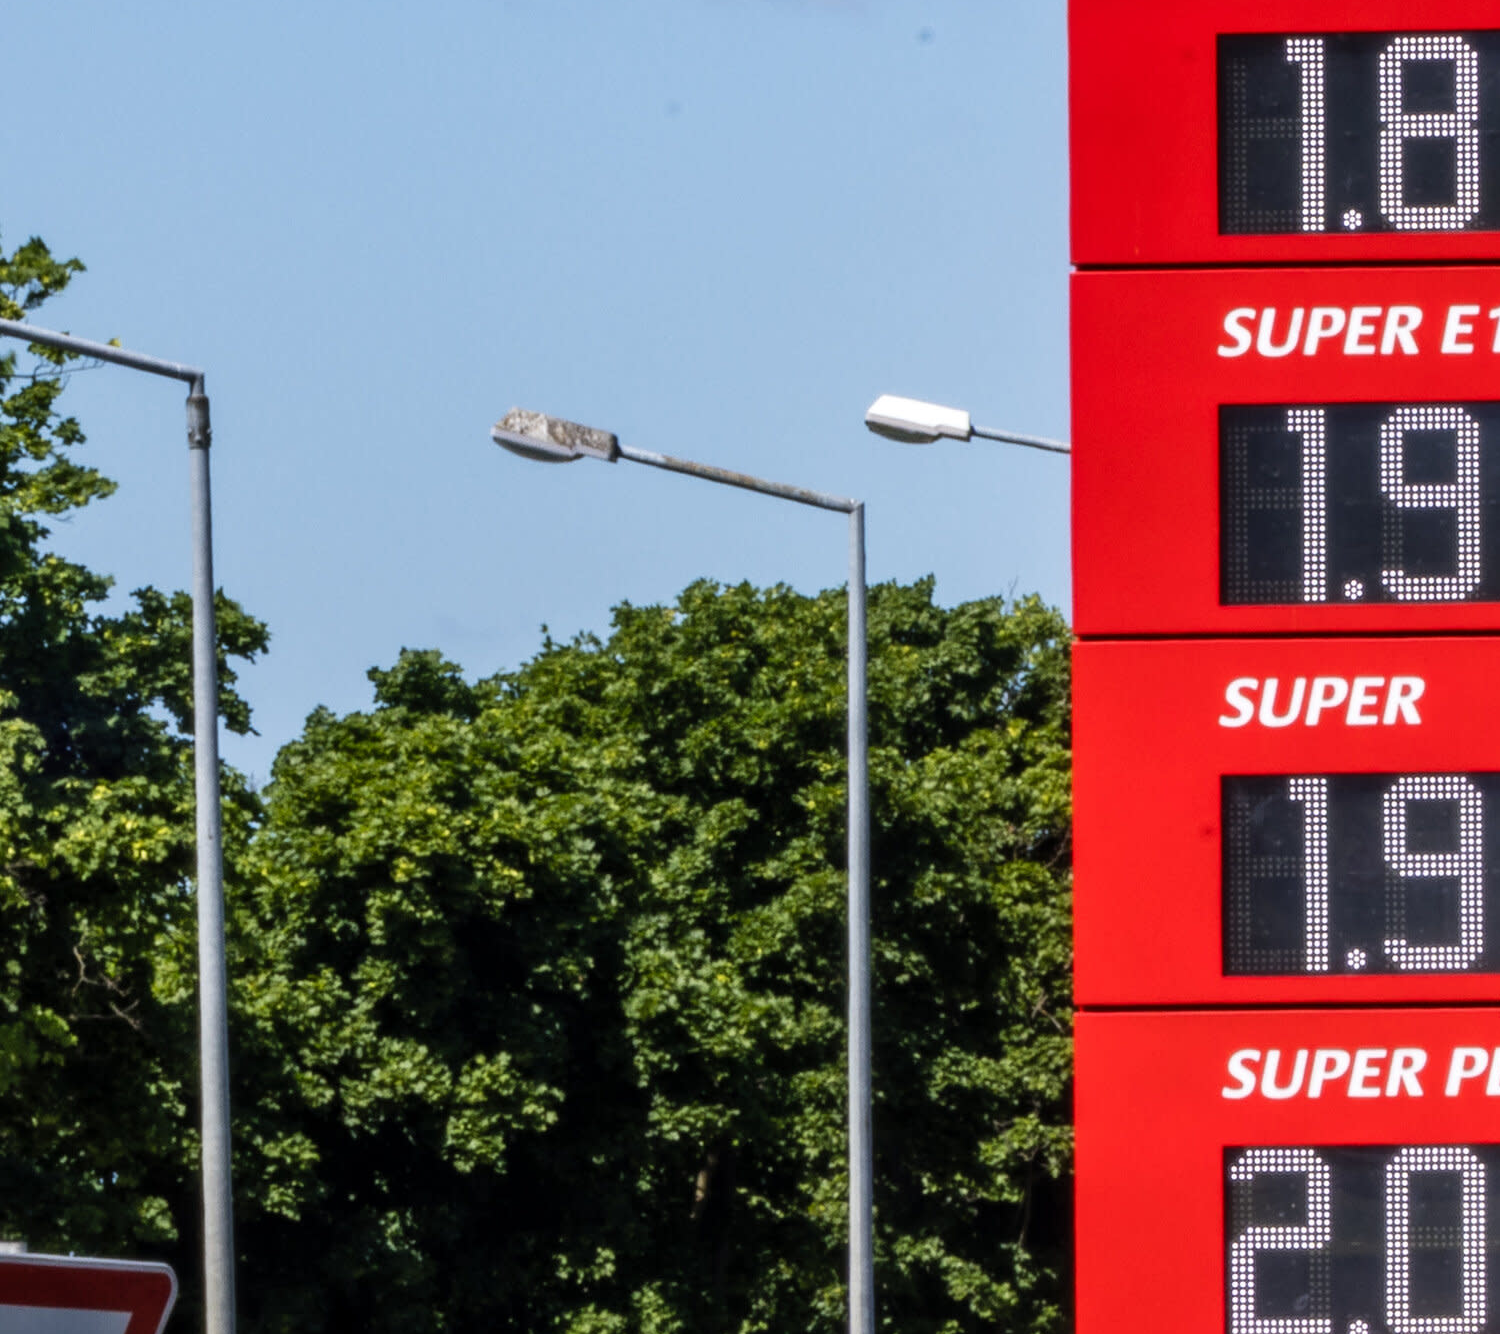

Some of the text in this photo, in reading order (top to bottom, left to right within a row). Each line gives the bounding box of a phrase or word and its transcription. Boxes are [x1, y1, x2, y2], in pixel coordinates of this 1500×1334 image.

[1217, 305, 1422, 358] SUPER
[1218, 676, 1425, 728] SUPER
[1222, 1048, 1427, 1100] SUPER
